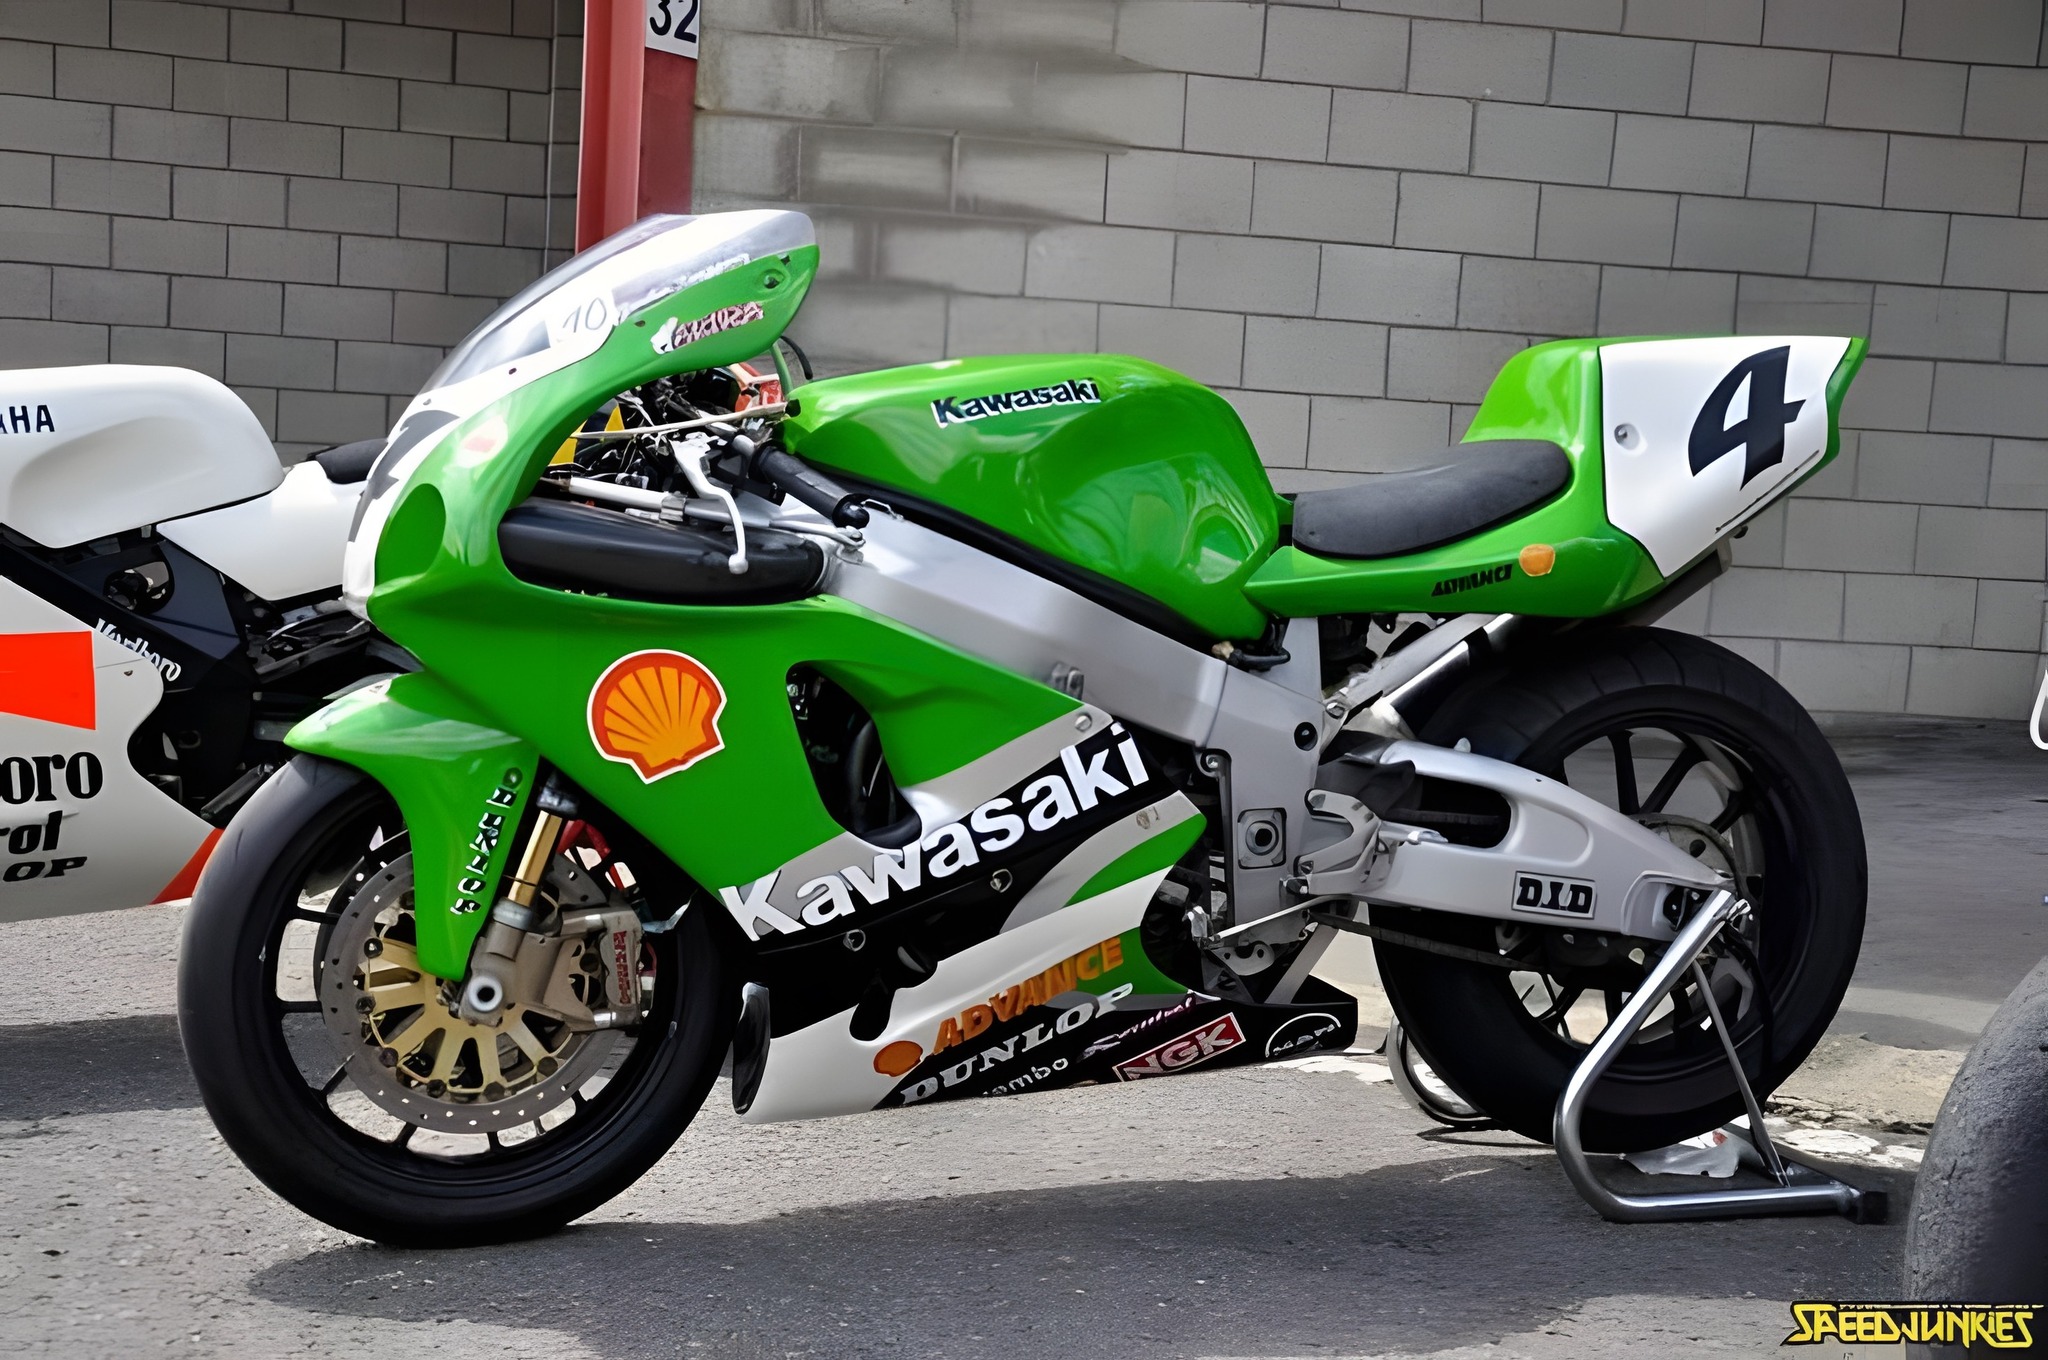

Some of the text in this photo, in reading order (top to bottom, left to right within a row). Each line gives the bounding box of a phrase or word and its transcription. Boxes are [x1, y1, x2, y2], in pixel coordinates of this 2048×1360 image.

[649, 0, 698, 43] 32
[930, 377, 1101, 428] Kawasaki
[1688, 345, 1806, 491] 4
[718, 722, 1150, 942] Kawasaki
[900, 982, 1134, 1104] DUNLOP
[932, 936, 1124, 1055] ADVANCE
[1122, 1022, 1235, 1081] NGK
